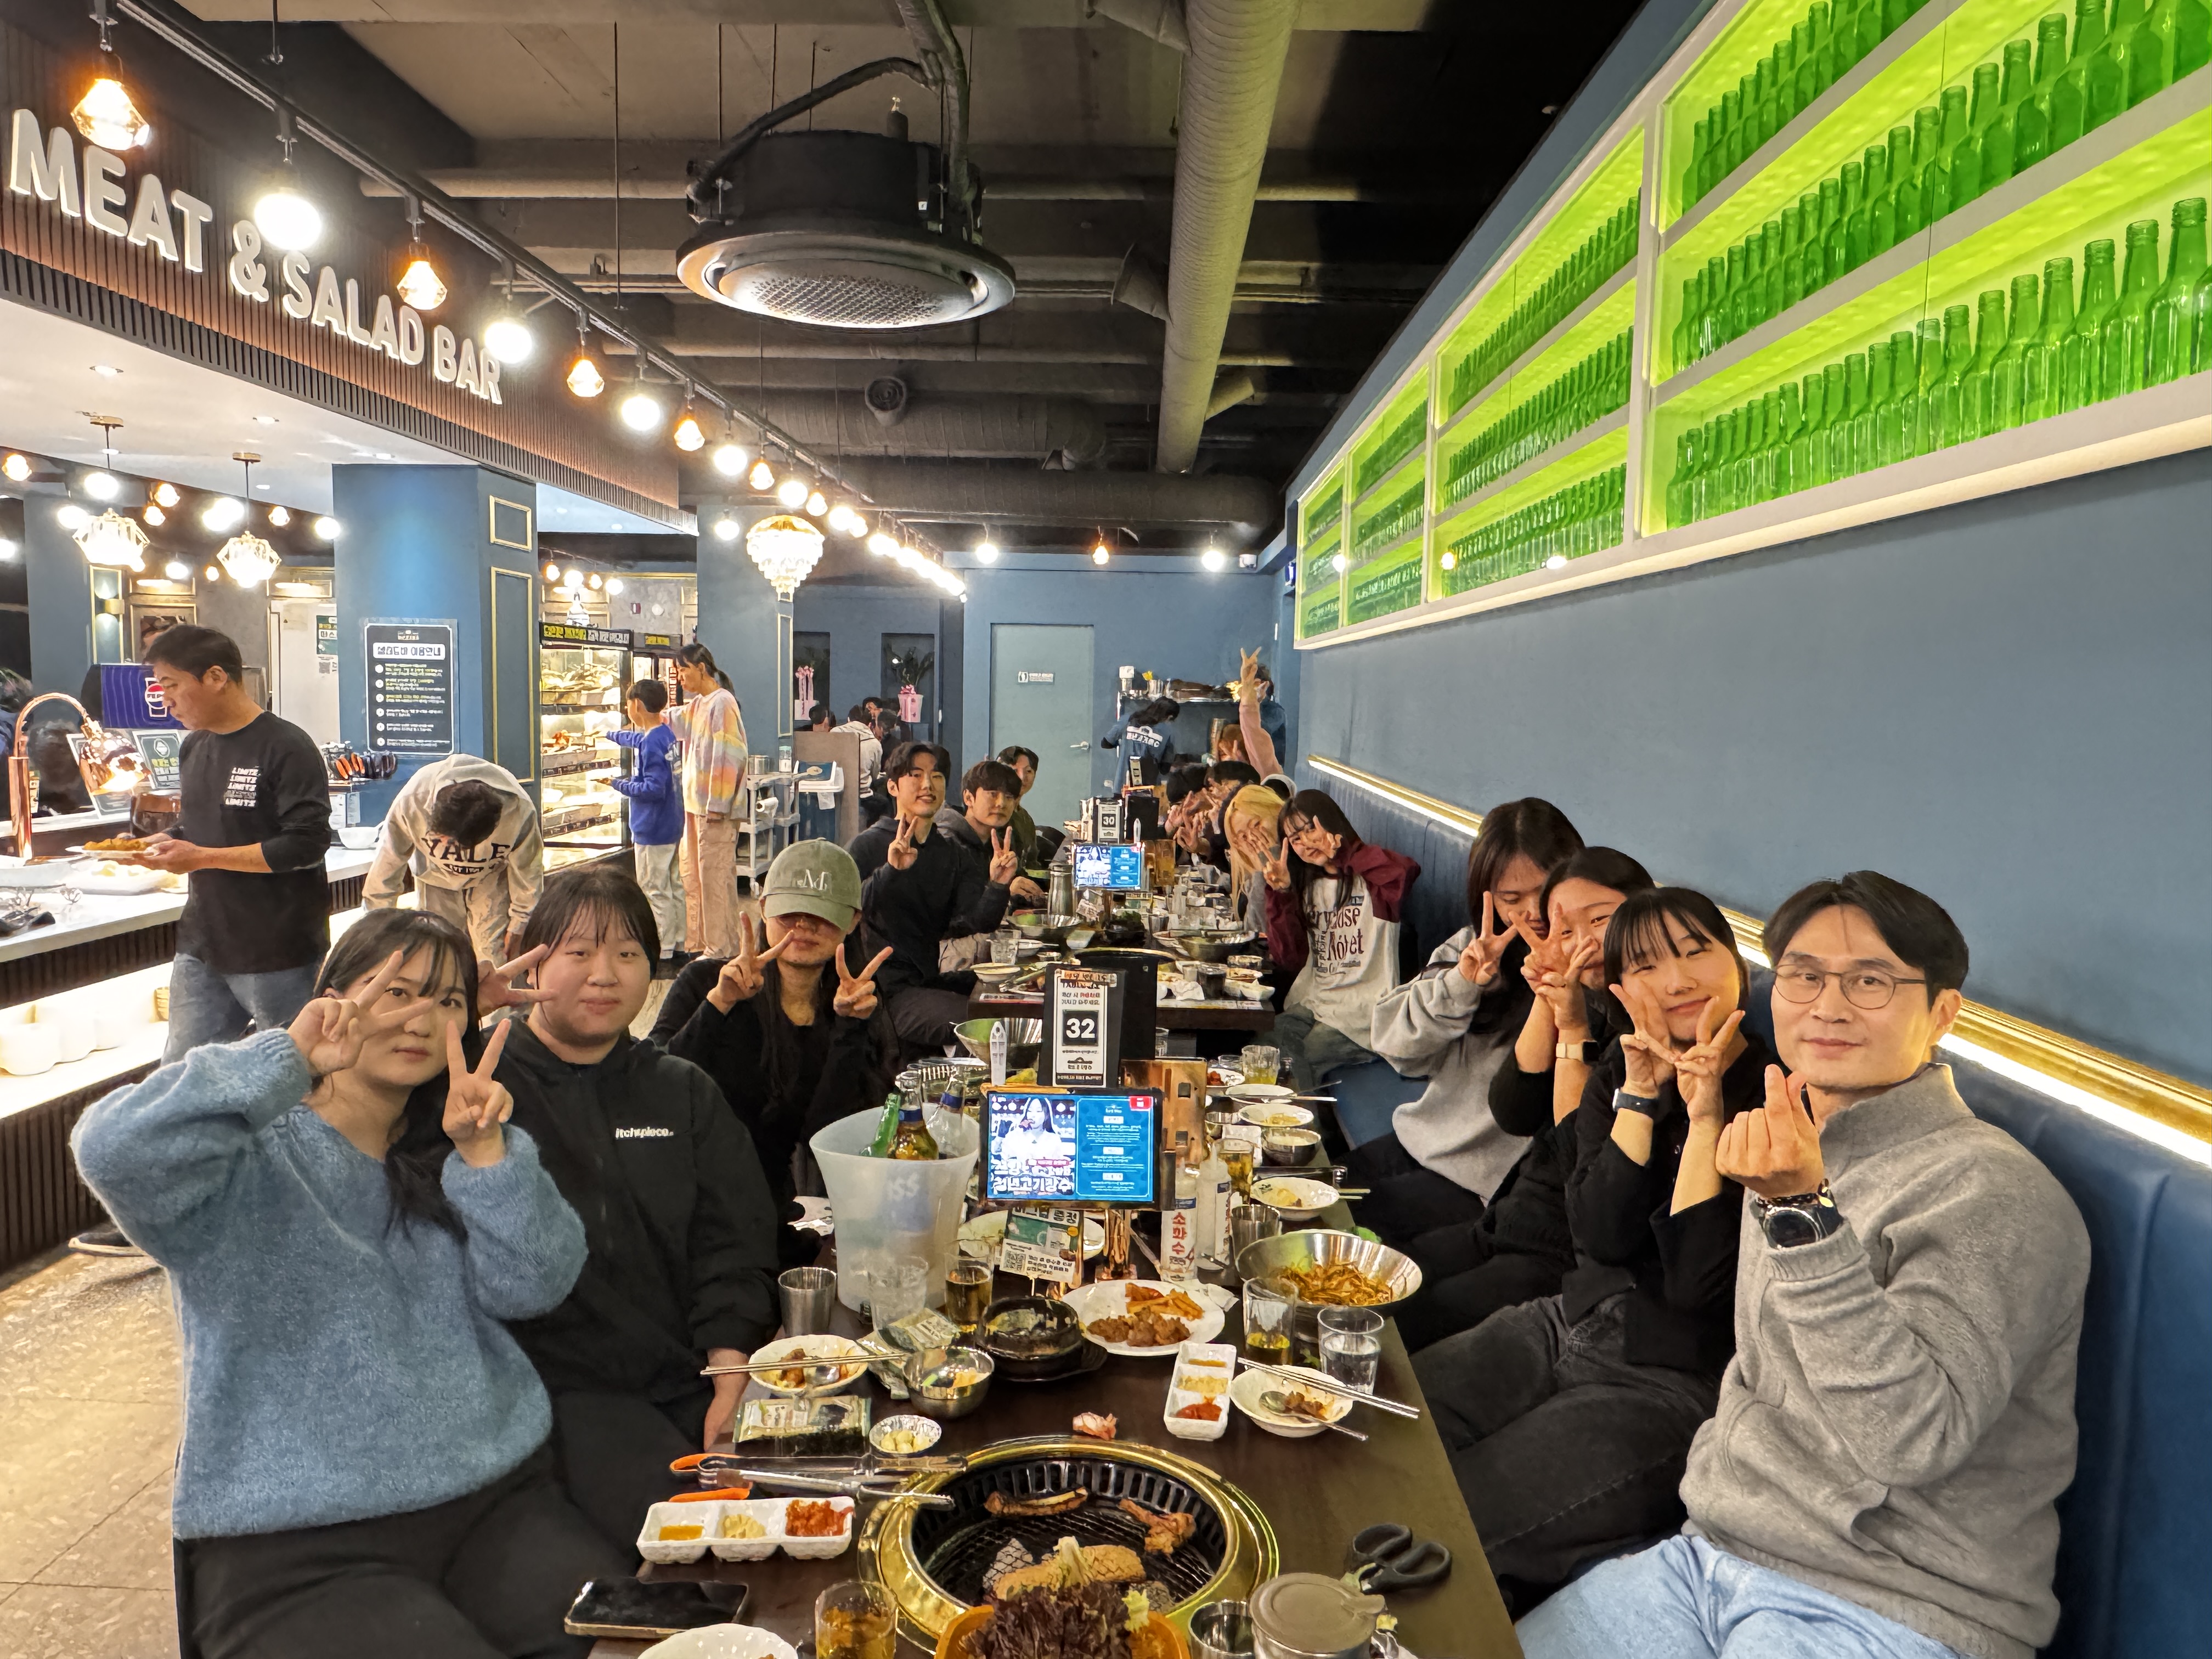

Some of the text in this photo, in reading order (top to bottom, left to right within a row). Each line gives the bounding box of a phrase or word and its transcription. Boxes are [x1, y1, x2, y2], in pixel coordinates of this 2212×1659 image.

[9, 109, 503, 405] MEAT & SALAD BAR
[1103, 816, 1115, 825] 30
[421, 837, 511, 862] YALE
[1066, 1018, 1096, 1039] 32
